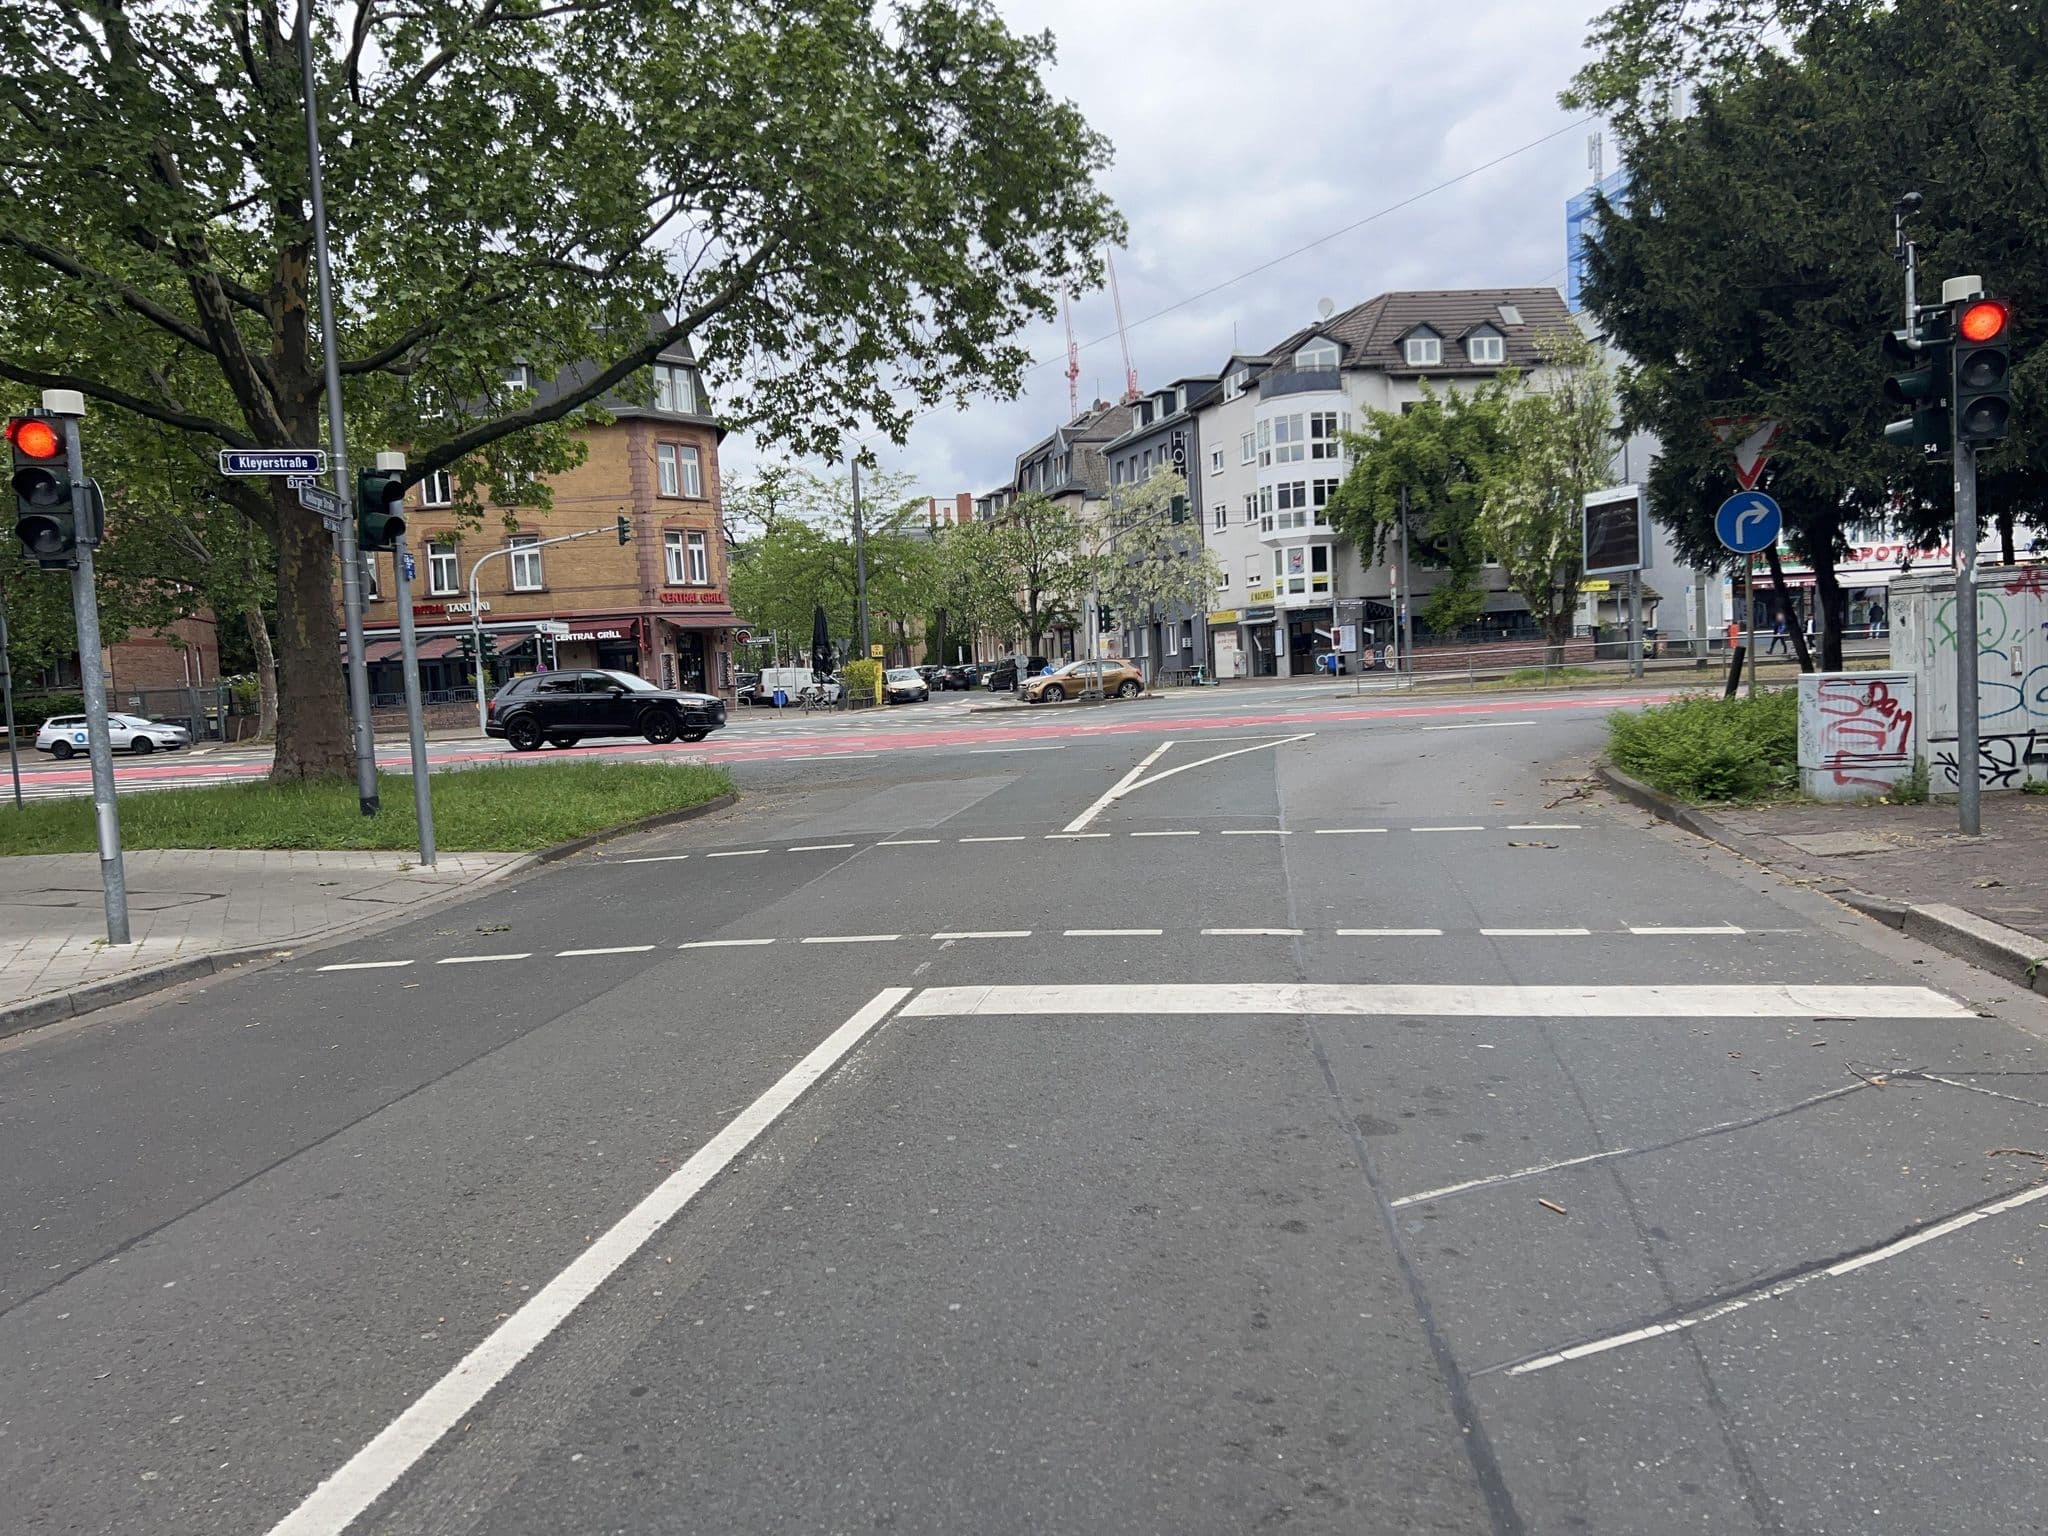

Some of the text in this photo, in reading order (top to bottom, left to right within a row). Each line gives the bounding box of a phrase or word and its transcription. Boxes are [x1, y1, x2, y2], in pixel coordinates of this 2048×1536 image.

[1172, 431, 1185, 480] HOT
[239, 456, 308, 471] Kleyerstraße
[660, 592, 724, 604] CENTRAL GRILL
[555, 632, 596, 642] CENTRAL
